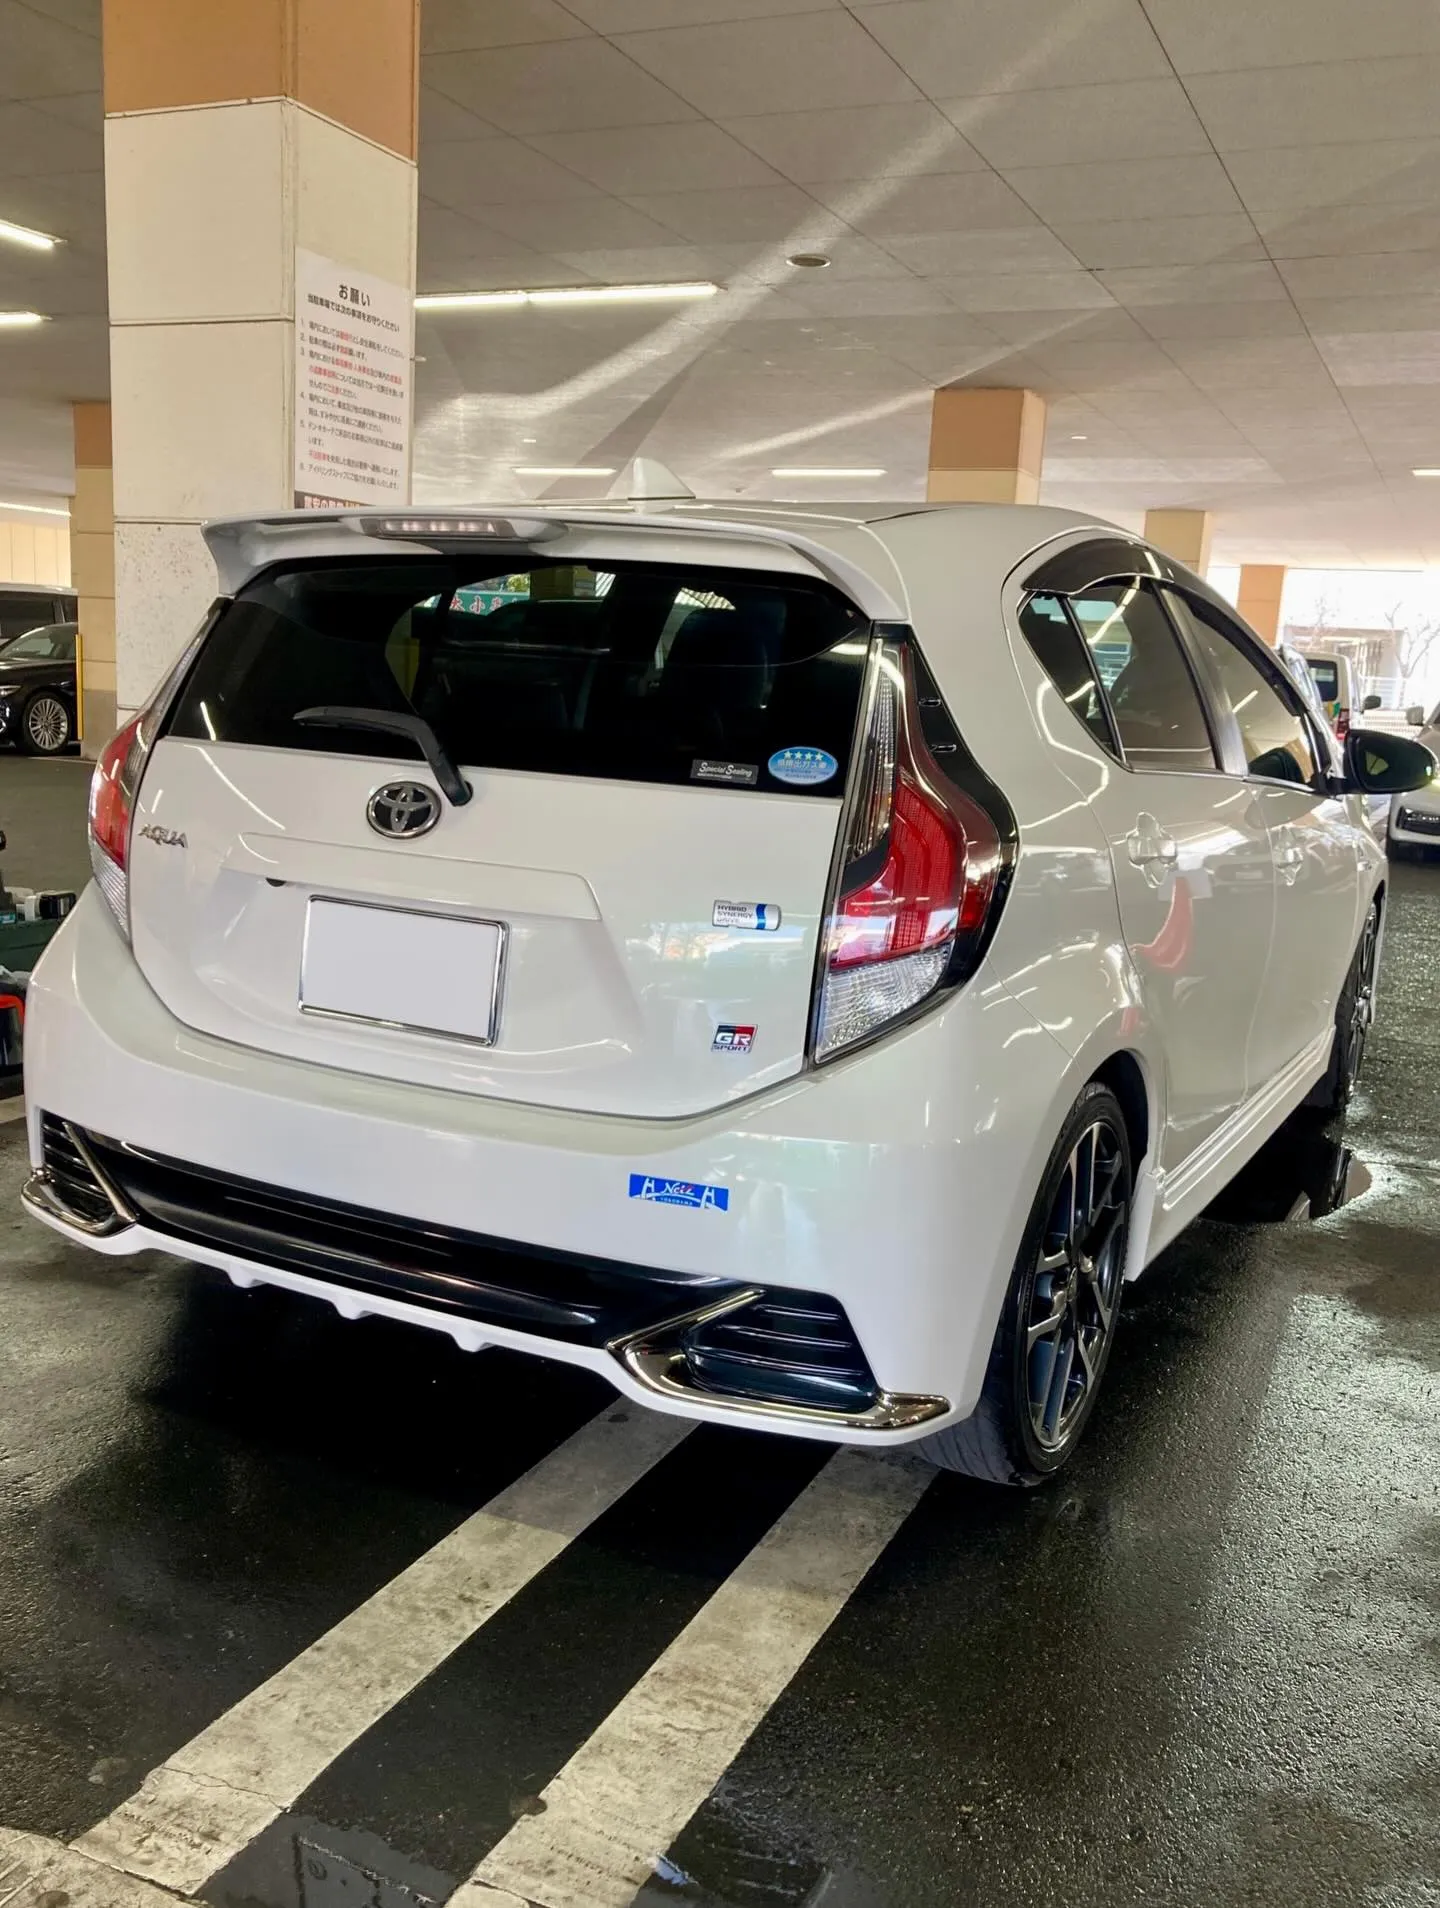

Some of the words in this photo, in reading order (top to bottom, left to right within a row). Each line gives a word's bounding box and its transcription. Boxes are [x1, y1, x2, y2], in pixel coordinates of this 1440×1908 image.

[338, 284, 371, 307] お願い
[699, 762, 726, 774] Special
[138, 823, 189, 849] AQUA
[717, 904, 748, 912] HYBRID
[717, 911, 754, 919] SYNERGY
[715, 1032, 752, 1046] GR
[712, 1044, 749, 1053] SPORT
